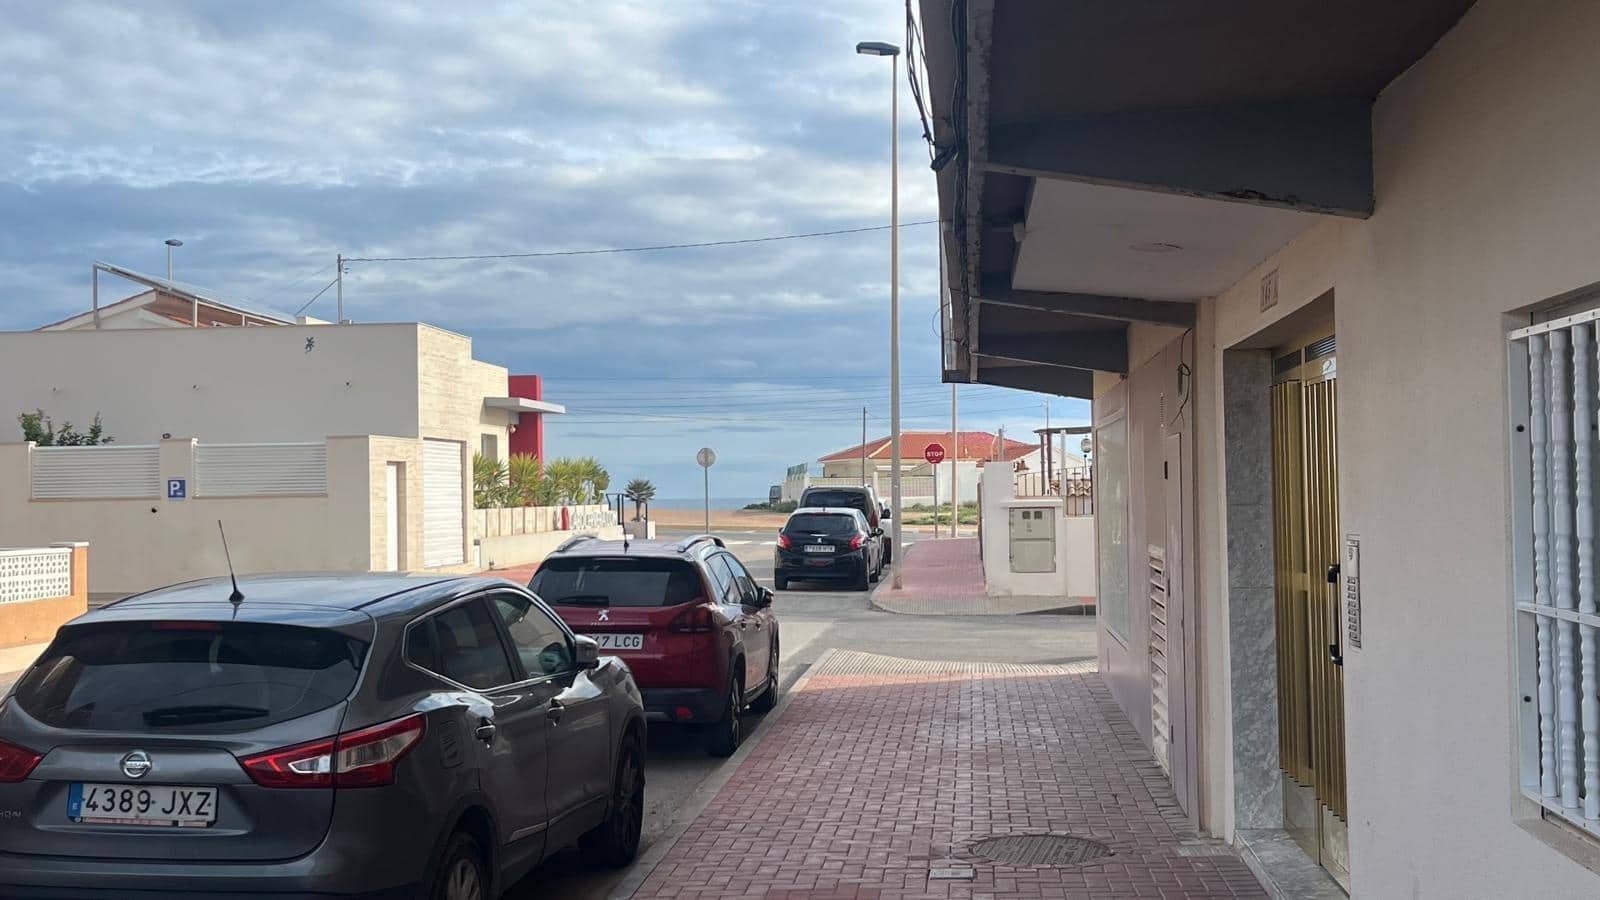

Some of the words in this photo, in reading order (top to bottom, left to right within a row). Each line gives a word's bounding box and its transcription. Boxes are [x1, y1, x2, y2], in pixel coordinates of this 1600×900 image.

[170, 481, 180, 496] P
[614, 636, 640, 648] LCG
[85, 788, 152, 814] 4389
[162, 790, 212, 816] JXZ
